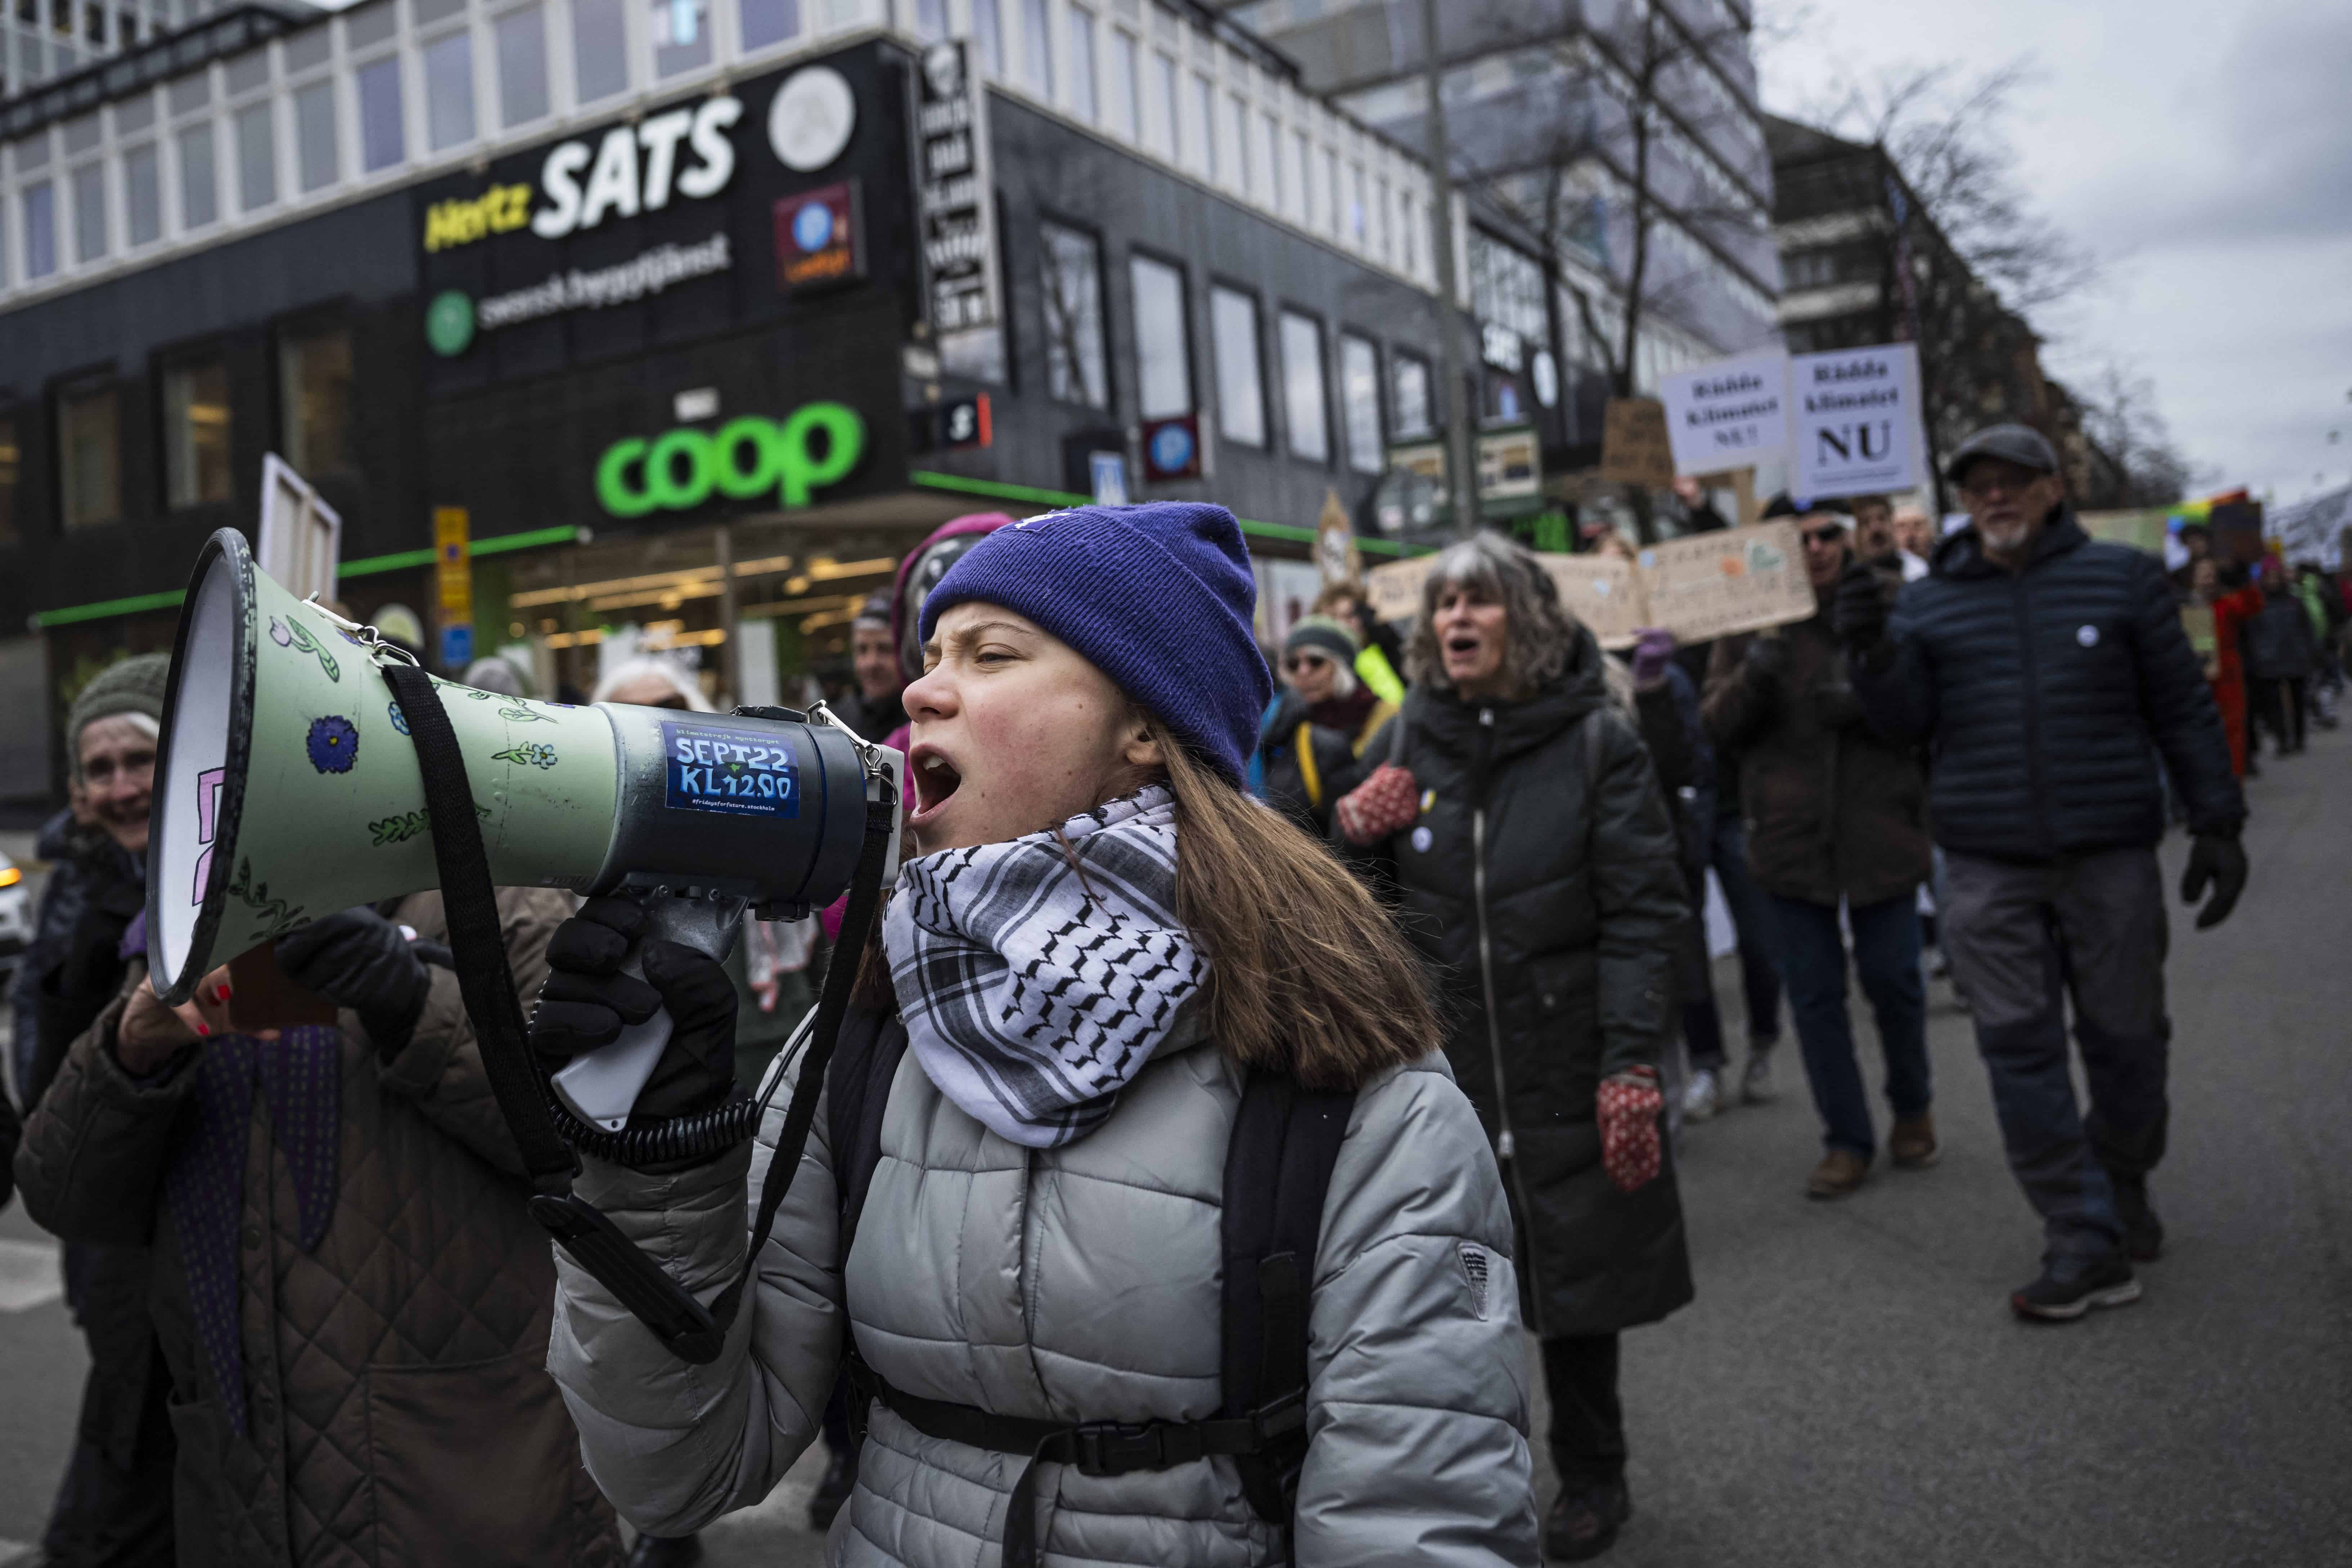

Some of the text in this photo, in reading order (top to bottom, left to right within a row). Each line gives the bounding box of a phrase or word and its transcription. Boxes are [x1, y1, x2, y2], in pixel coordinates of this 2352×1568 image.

[531, 96, 744, 239] SATS
[425, 182, 532, 252] Hertz
[595, 401, 864, 517] coop
[1817, 420, 1891, 466] NU
[676, 729, 779, 744] klimatstrejk mynttorget
[692, 798, 775, 811] @fridaysforfuture.stockholm
